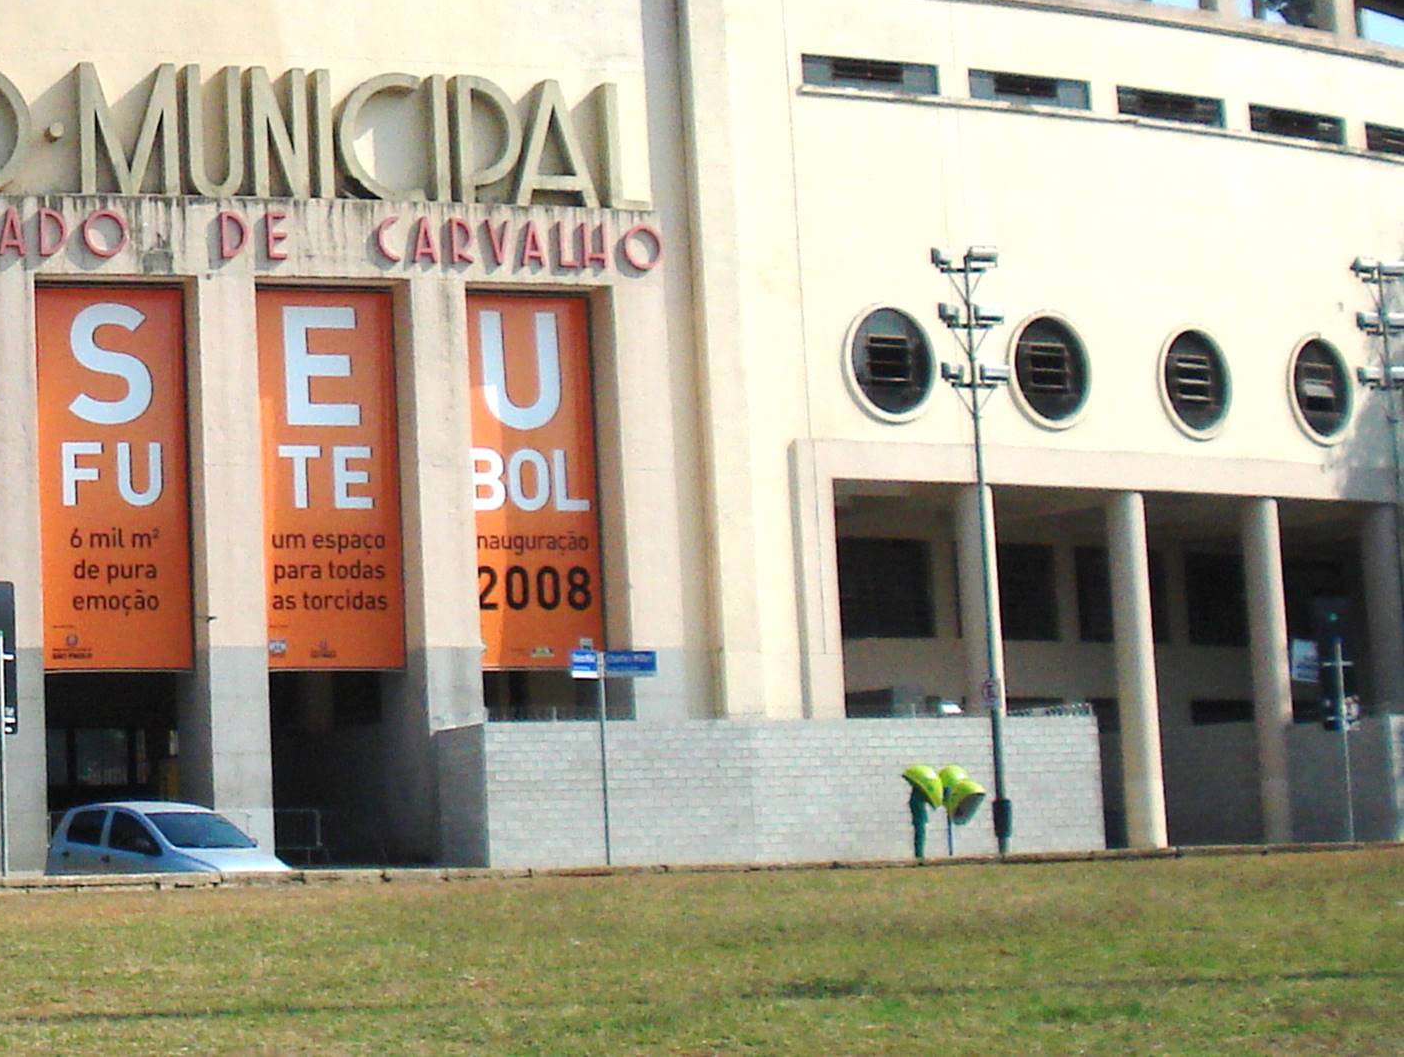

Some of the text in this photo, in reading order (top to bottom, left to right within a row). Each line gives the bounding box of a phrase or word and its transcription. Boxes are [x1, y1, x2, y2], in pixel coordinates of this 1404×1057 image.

[76, 60, 653, 211] MUNICIPAL
[218, 211, 288, 261] DE
[377, 215, 663, 271] CARVALHO
[68, 302, 154, 426] S
[281, 305, 362, 427] E
[479, 310, 563, 431] U
[61, 441, 164, 508] FU
[279, 445, 376, 511] TE
[468, 446, 591, 512] BOL
[70, 527, 83, 548] 6
[90, 526, 124, 548] mil
[272, 533, 386, 555] um espaço
[73, 559, 158, 584] de pura
[272, 589, 388, 610] as torcidas
[274, 559, 386, 584] para todas
[478, 564, 592, 611] 2008
[72, 589, 160, 616] emoção
